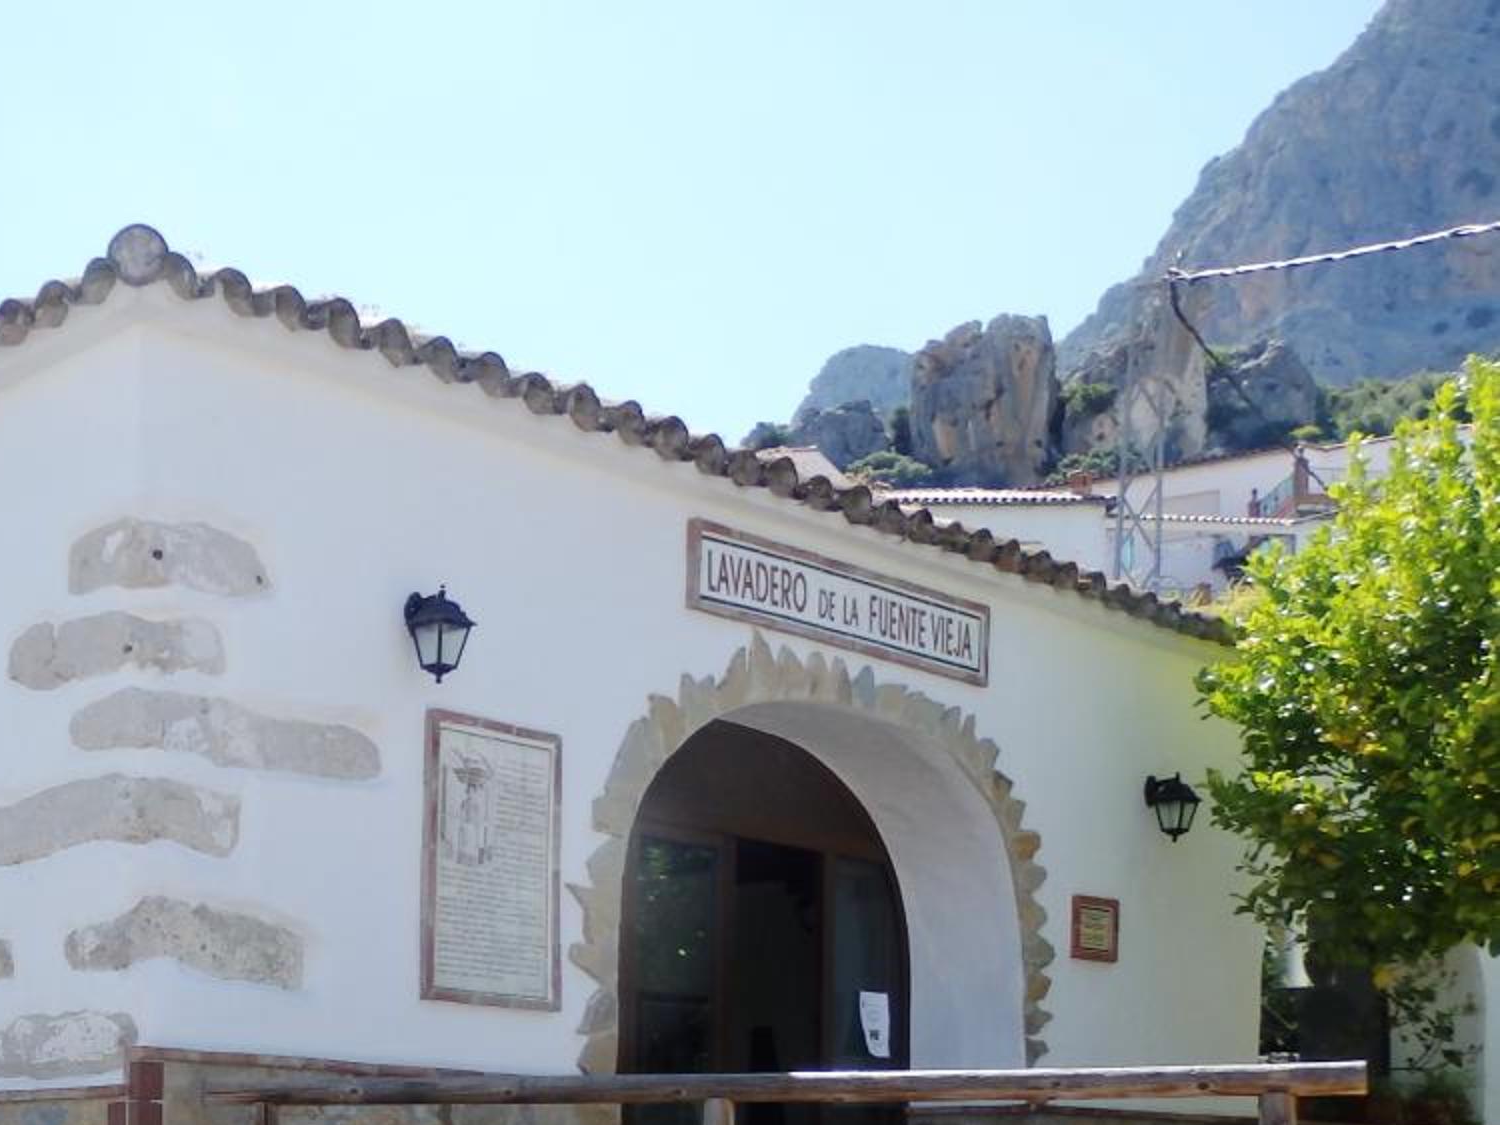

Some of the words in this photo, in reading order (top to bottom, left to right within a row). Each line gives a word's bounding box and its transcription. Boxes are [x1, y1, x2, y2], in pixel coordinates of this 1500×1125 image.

[707, 549, 807, 613] LAVADERO
[817, 588, 835, 621] DE
[842, 594, 859, 627] LA
[869, 595, 926, 648] FUENTE
[930, 613, 973, 660] VIEJA
